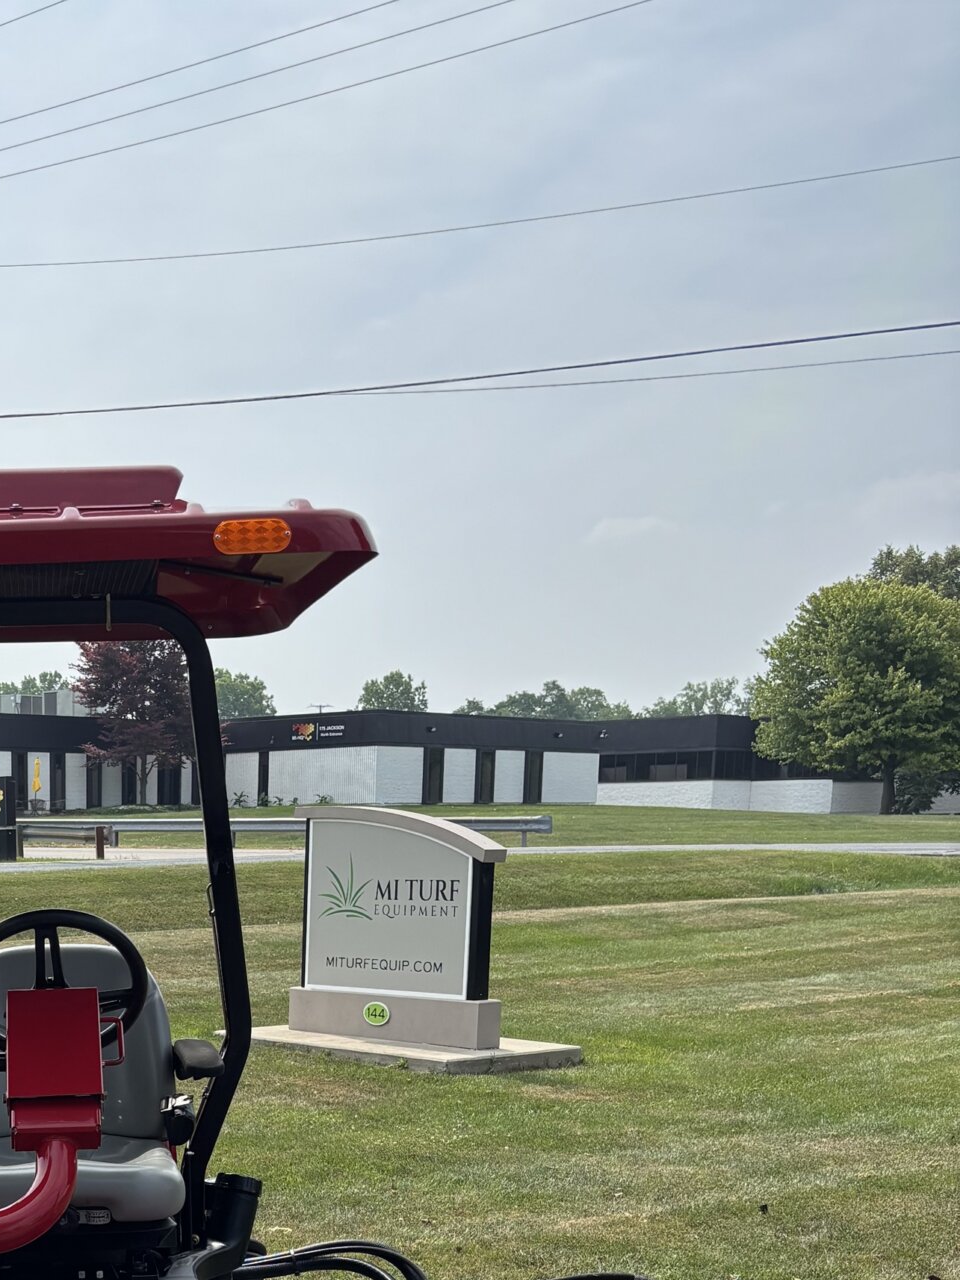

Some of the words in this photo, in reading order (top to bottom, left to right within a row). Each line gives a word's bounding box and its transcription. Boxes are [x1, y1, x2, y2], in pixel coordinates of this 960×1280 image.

[374, 879, 400, 901] MI
[405, 879, 461, 902] TURF
[374, 904, 459, 918] EQUIPMENT
[325, 956, 443, 974] MITURFEQUIP.COM
[367, 1007, 385, 1019] 144
